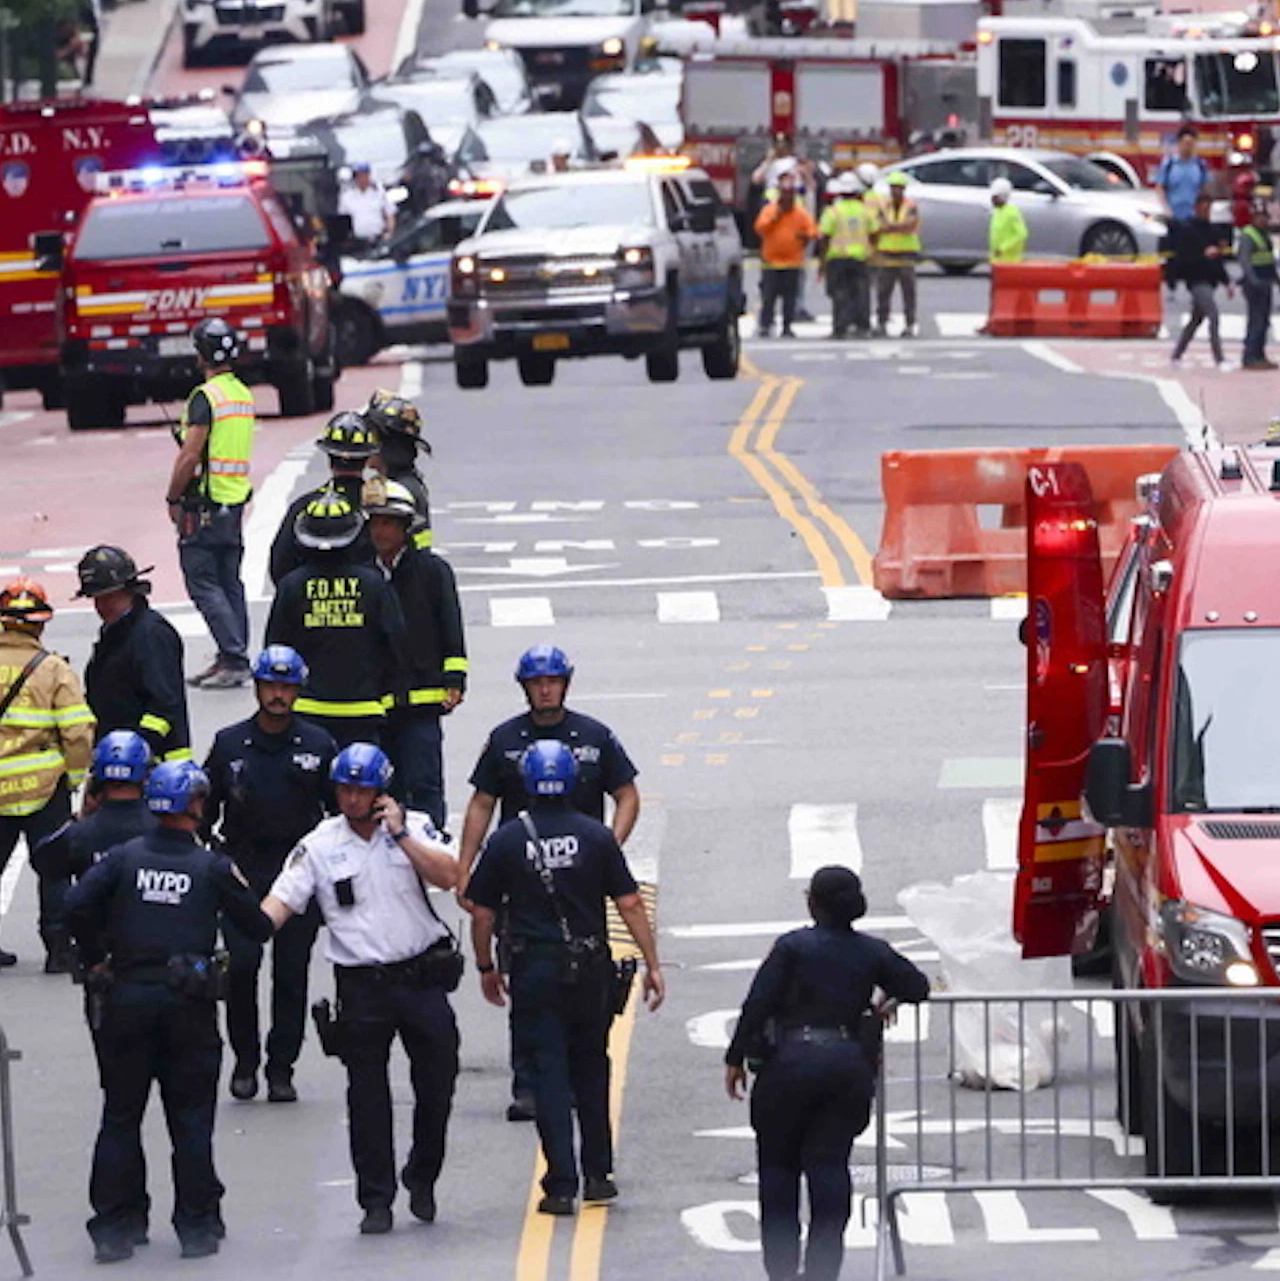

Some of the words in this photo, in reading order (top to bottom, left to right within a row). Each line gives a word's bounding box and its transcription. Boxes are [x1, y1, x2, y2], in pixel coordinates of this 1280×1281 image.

[62, 127, 111, 150] N.Y.
[144, 286, 210, 311] FDNY
[525, 835, 580, 862] NYPD
[136, 868, 193, 894] NYPD
